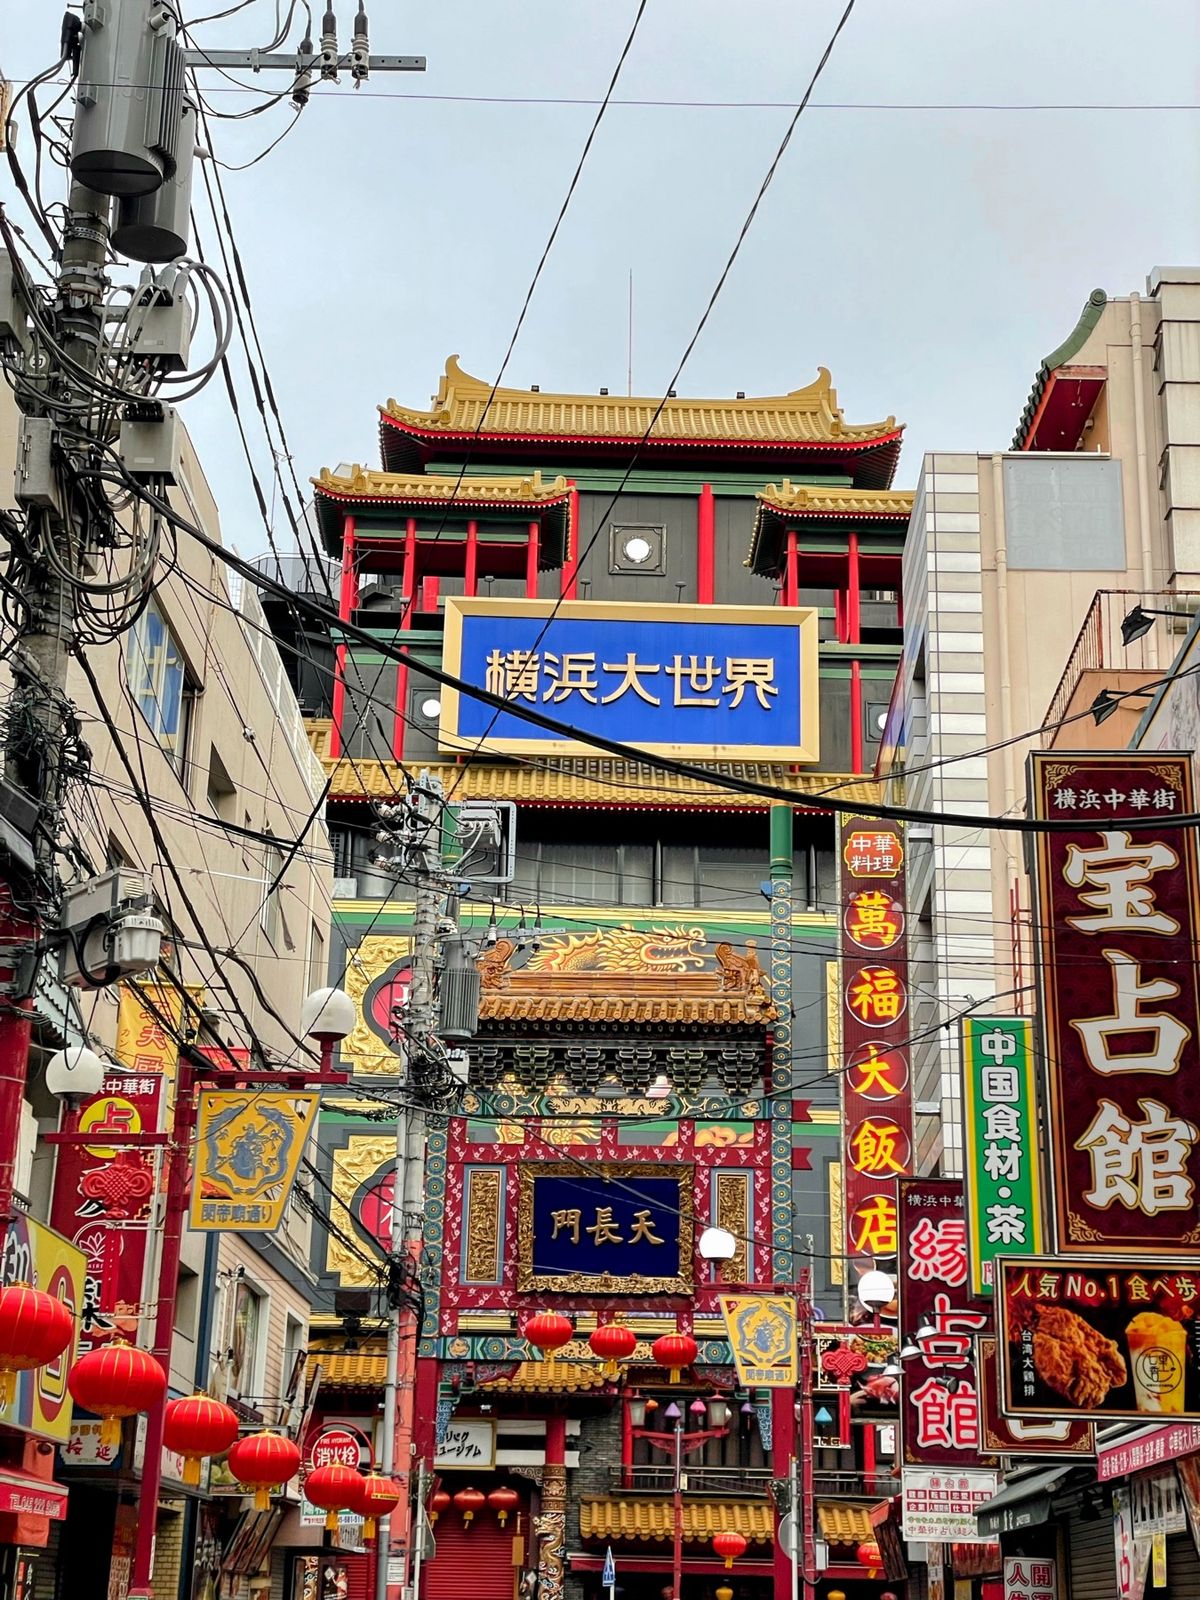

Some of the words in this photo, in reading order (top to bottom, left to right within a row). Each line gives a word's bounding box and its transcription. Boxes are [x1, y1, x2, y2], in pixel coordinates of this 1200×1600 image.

[486, 649, 778, 709] 横浜大世界
[1053, 788, 1177, 811] 横浜中華街
[851, 854, 898, 872] 料理
[852, 835, 896, 853] 中華
[1062, 832, 1200, 1216] 宝占館
[851, 890, 906, 1253] 萬福大飯店
[980, 1027, 1027, 1245] 中国食材・茶
[316, 1446, 357, 1467] 消火栓
